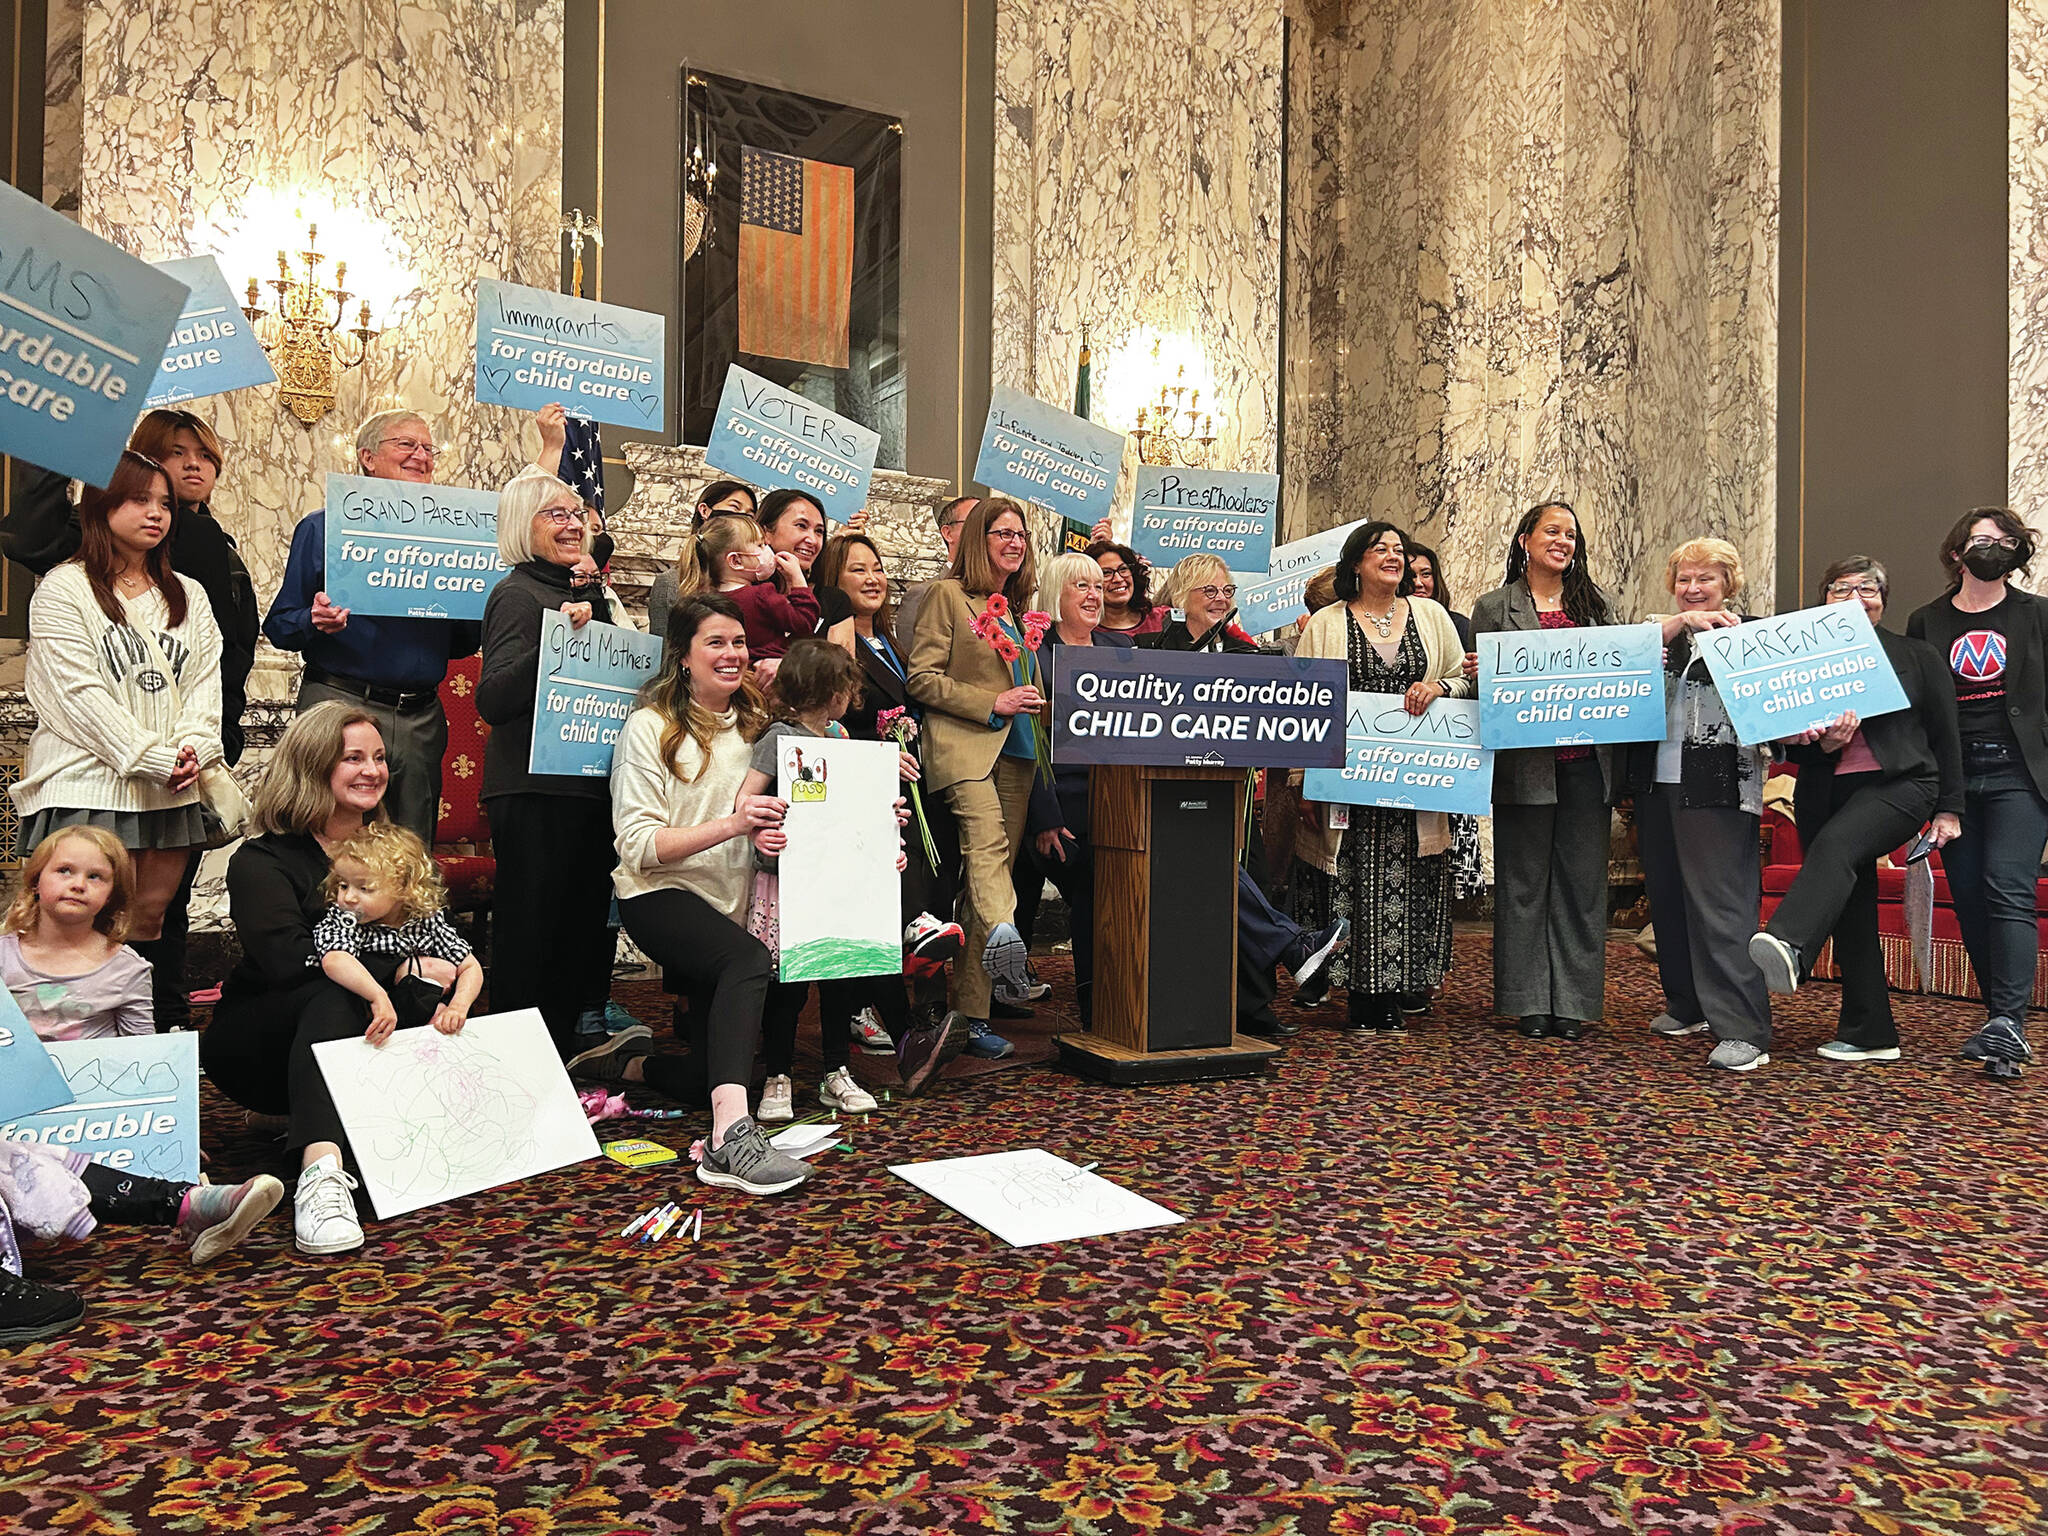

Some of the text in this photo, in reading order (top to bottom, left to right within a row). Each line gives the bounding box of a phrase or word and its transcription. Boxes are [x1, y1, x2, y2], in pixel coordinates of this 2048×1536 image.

[0, 247, 100, 320] MS
[499, 291, 618, 346] Immigrants
[0, 324, 128, 401] rdable
[161, 349, 222, 373] care
[490, 338, 653, 385] for affordable
[514, 367, 630, 401] child care
[740, 379, 857, 457] VOTERS
[726, 417, 860, 488] for affordable
[992, 434, 1108, 491] for affordable
[742, 445, 838, 496] child care
[1006, 460, 1088, 501] child care
[343, 491, 417, 523] GRAND
[1143, 513, 1265, 536] for affordable
[341, 541, 508, 573] for affordable
[1159, 532, 1246, 551] child care
[367, 567, 486, 593] child care
[1246, 590, 1272, 606] for
[598, 632, 652, 670] Mothers
[1713, 611, 1856, 670] PARENTS
[1075, 672, 1334, 707] Quality, affordable
[1492, 680, 1652, 705] for affordable
[1731, 654, 1878, 700] for affordable
[546, 688, 571, 713] for
[1762, 679, 1866, 714] child care
[1068, 710, 1332, 743] CHILD CARE NOW
[1516, 703, 1631, 724] child care
[560, 719, 620, 746] child ca
[1357, 746, 1481, 771] affordable
[1340, 764, 1456, 789] child care
[92, 1148, 135, 1169] re
